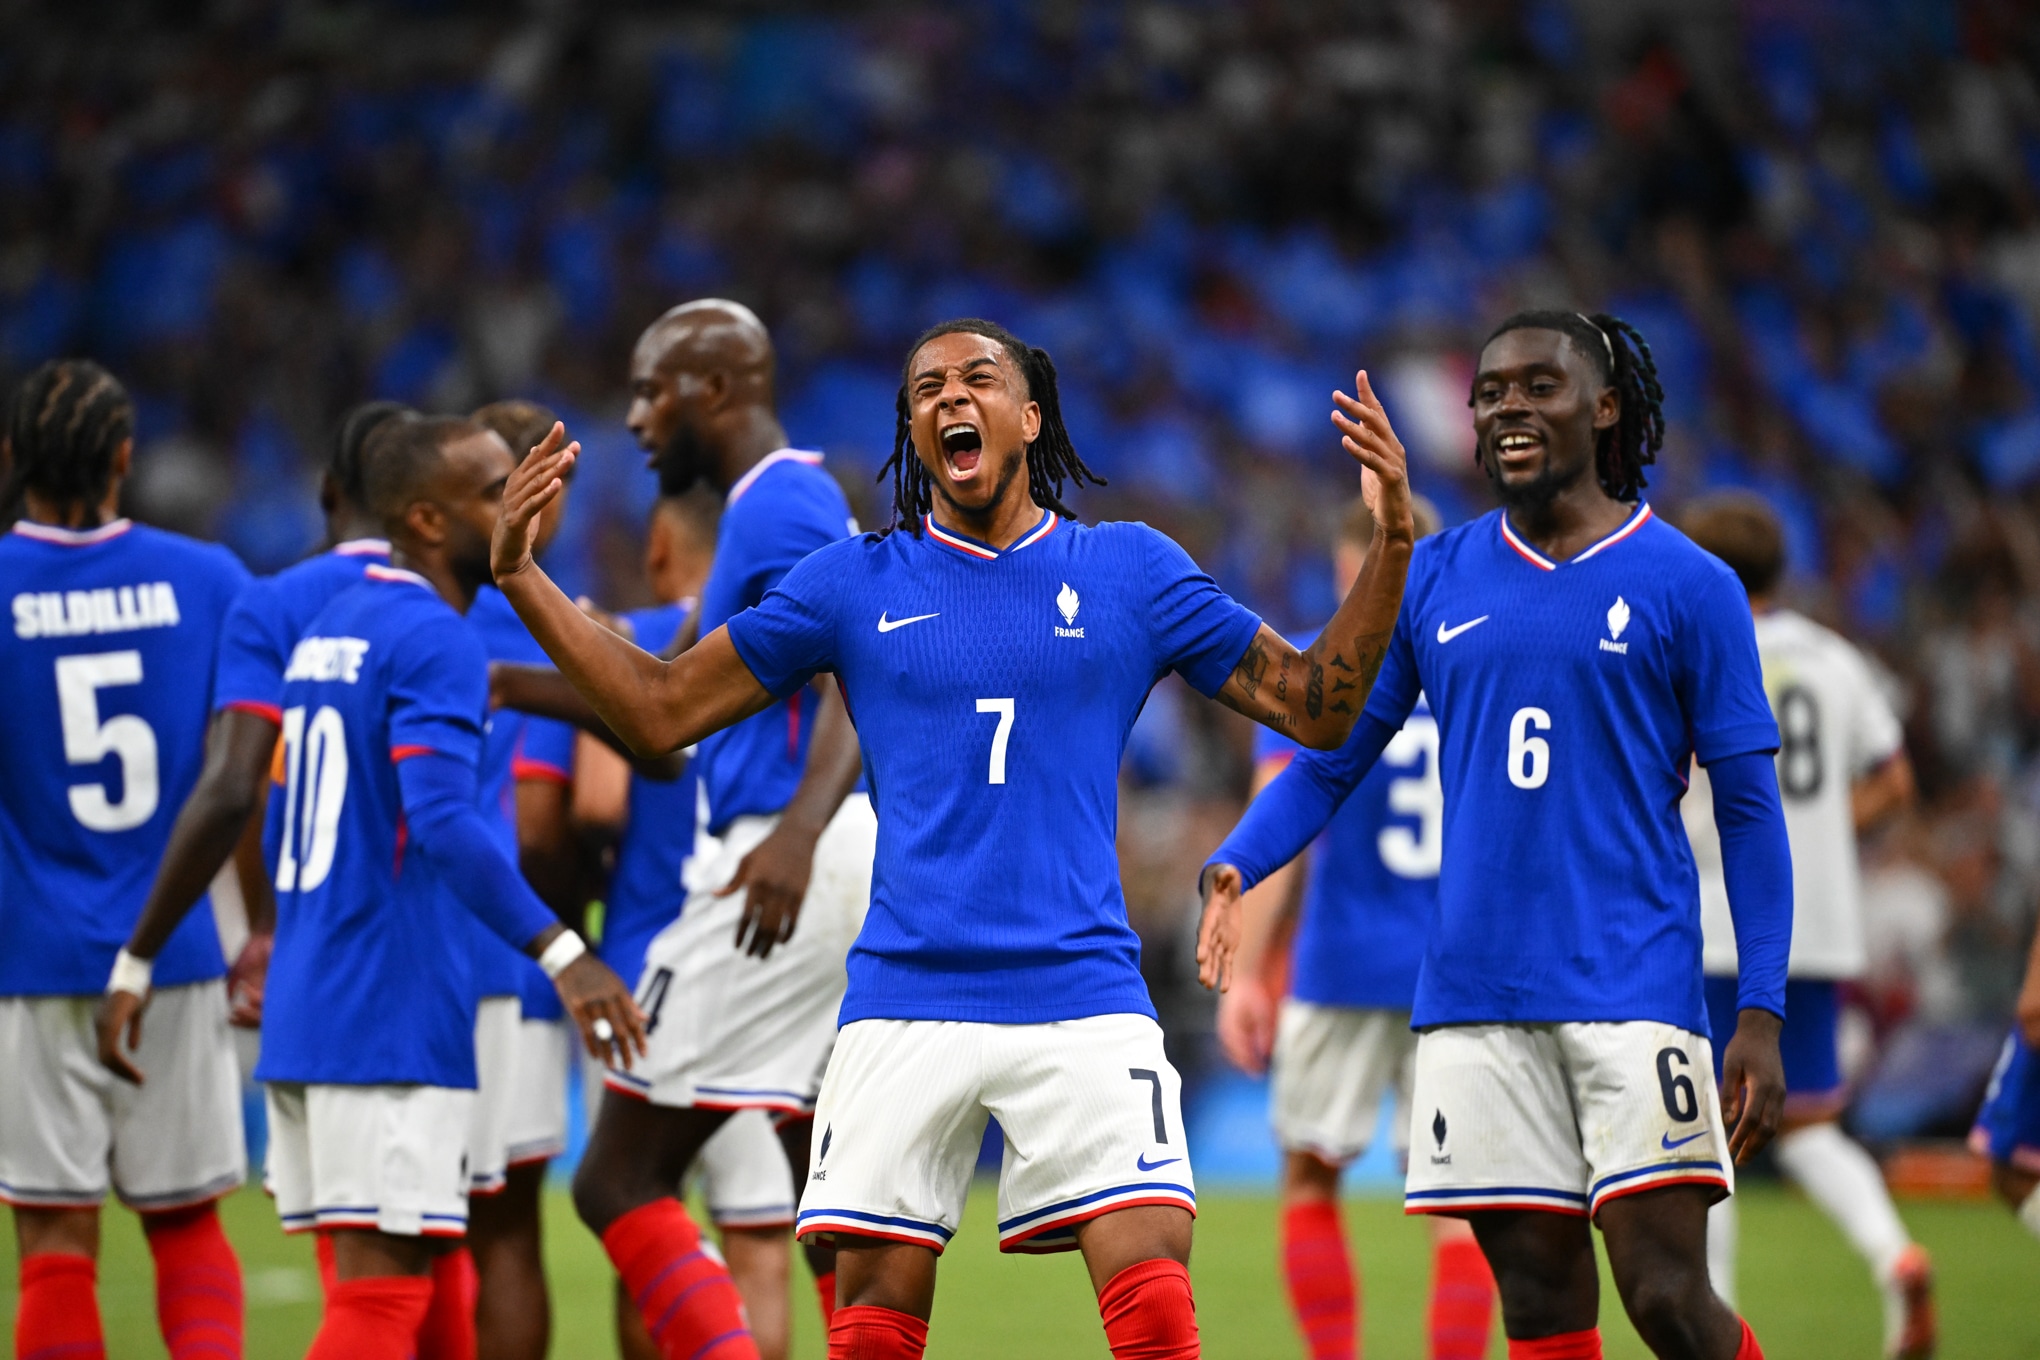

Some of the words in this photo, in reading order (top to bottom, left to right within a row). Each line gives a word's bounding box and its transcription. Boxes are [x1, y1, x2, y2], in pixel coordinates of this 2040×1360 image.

[12, 581, 180, 638] SILDILLIA
[1054, 625, 1085, 639] FRANCE
[1598, 637, 1629, 655] FRANCE
[55, 650, 159, 831] 5
[975, 697, 1015, 785] 7
[1507, 706, 1552, 789] 6
[1776, 683, 1825, 804] 8
[275, 704, 349, 892] 10
[1377, 715, 1444, 878] 3
[1128, 1068, 1168, 1144] 7
[1656, 1047, 1699, 1123] 6
